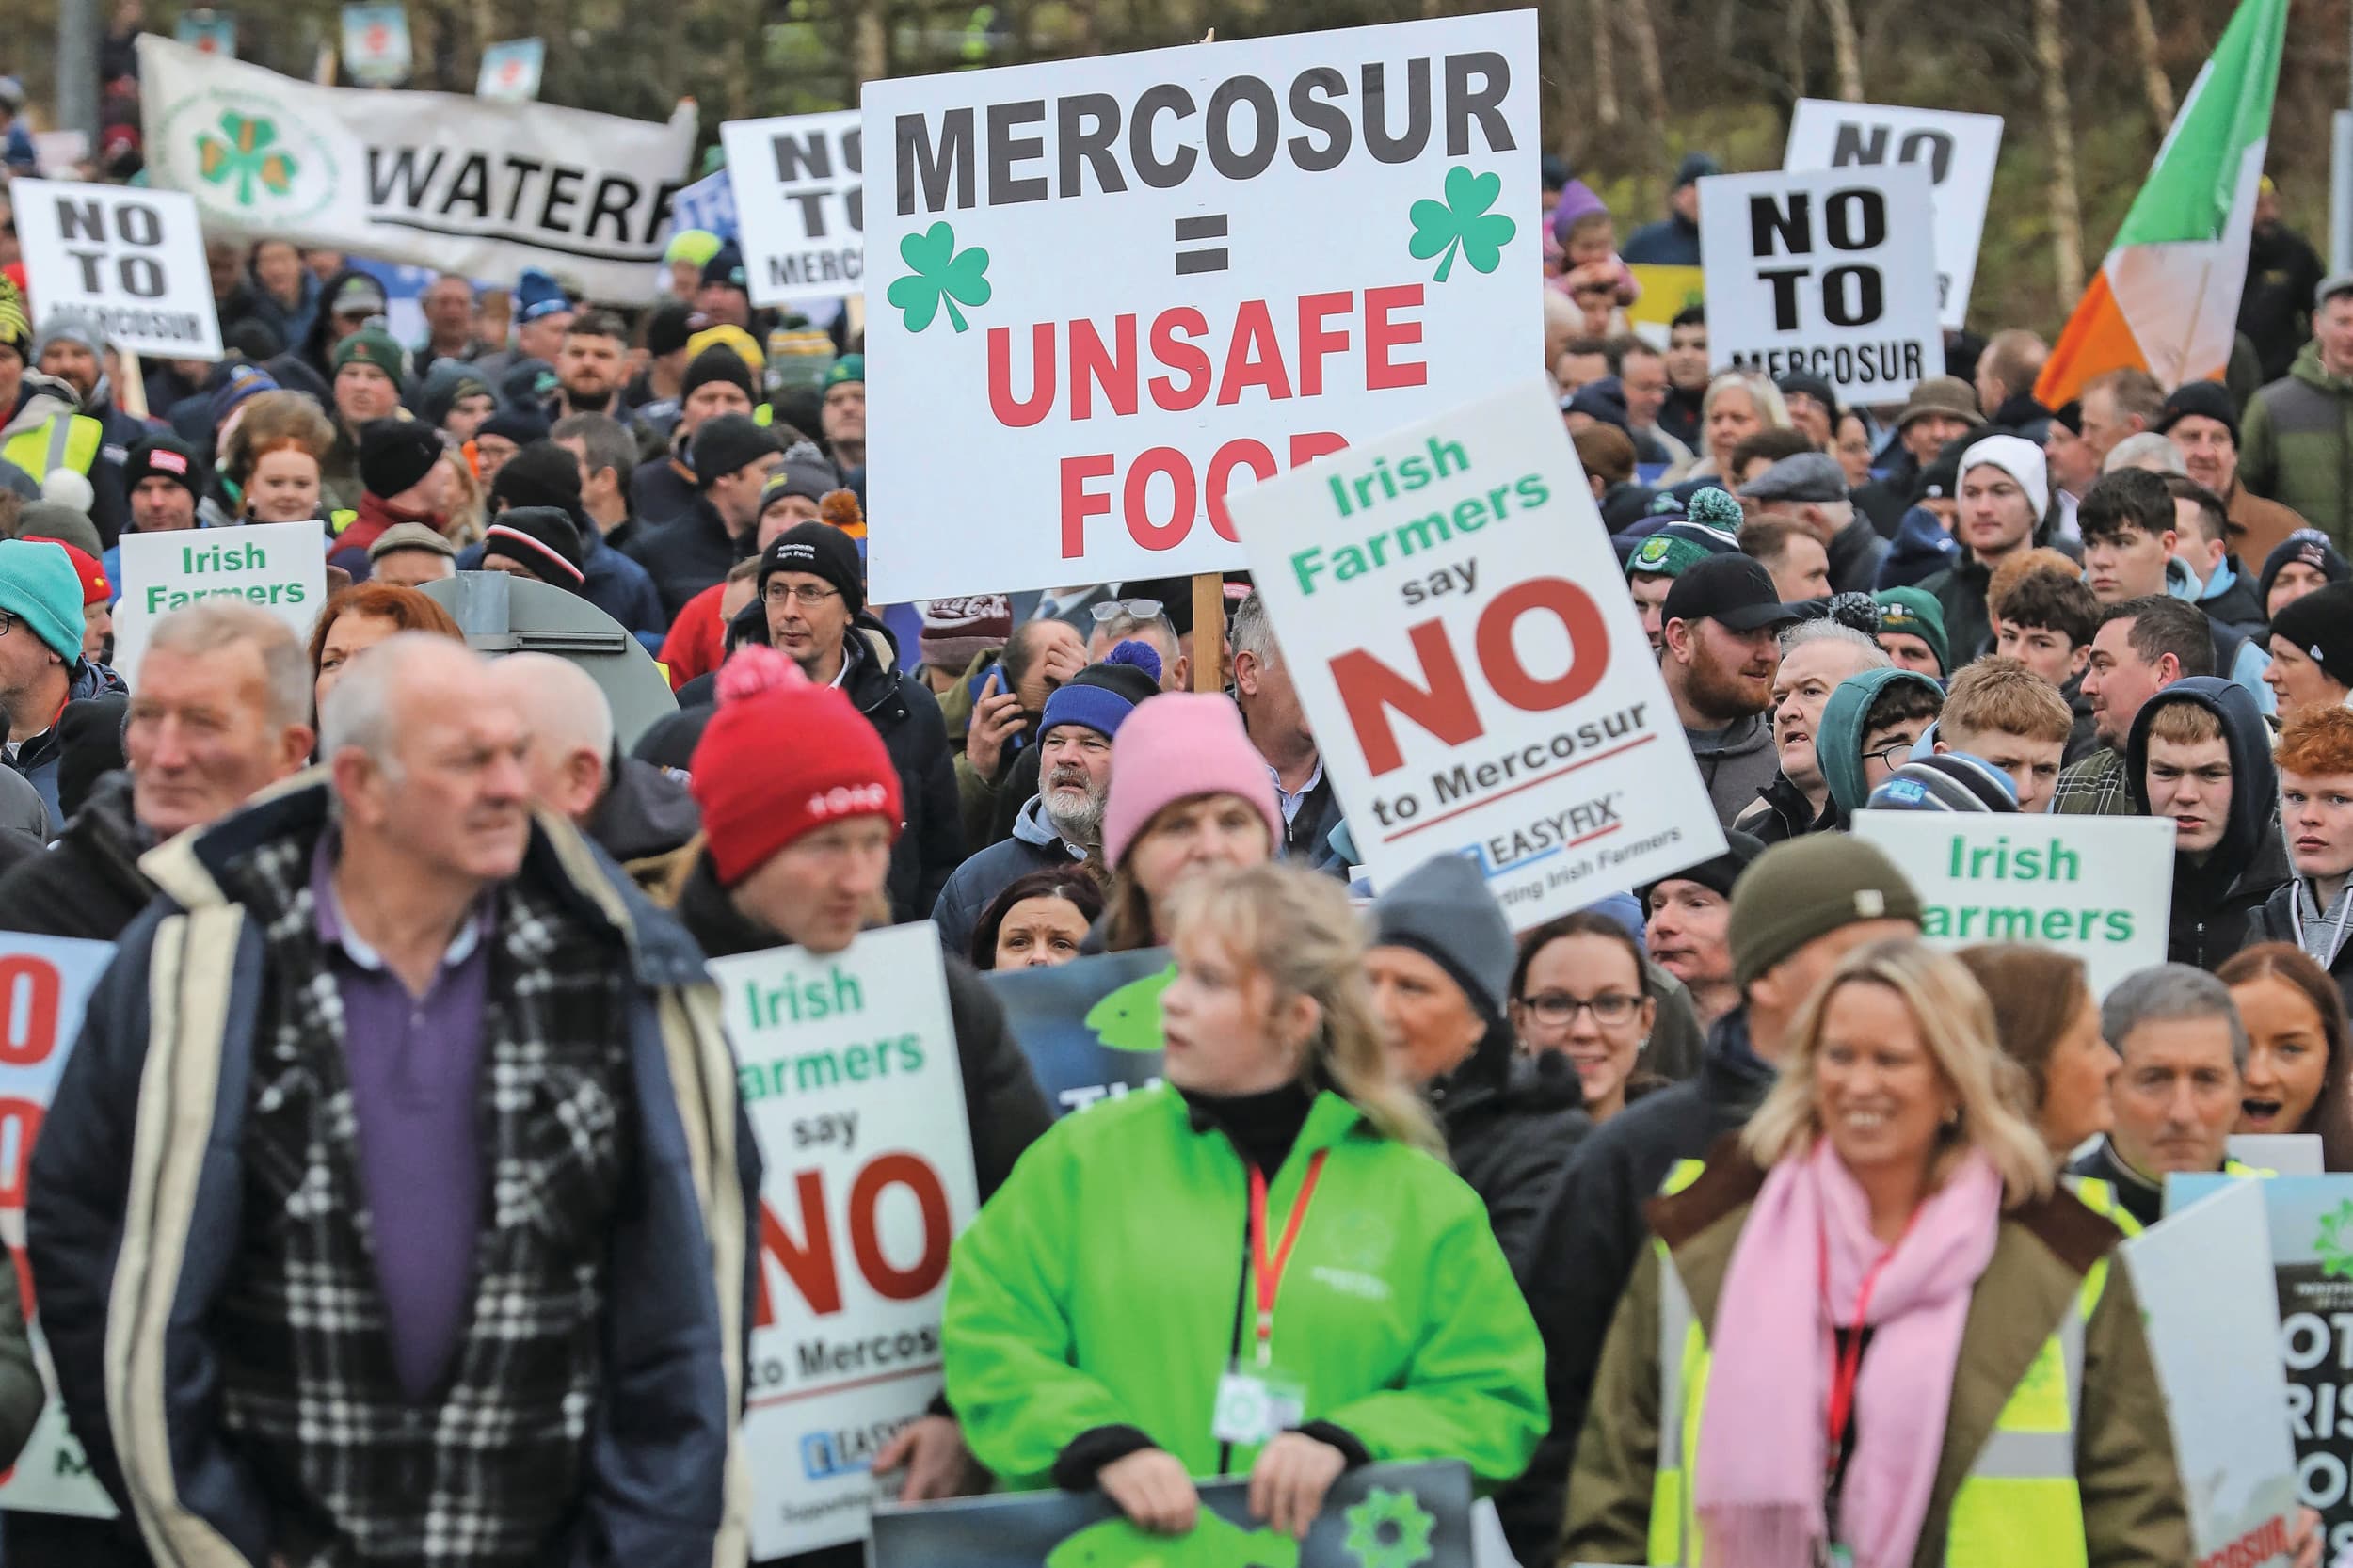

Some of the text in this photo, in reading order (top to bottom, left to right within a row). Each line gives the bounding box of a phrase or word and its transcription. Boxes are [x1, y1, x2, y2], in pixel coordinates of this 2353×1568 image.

[895, 51, 1518, 216] MERCOSUR
[55, 196, 164, 247] NO
[1749, 188, 1886, 257] NO
[67, 248, 166, 298] TO
[1756, 265, 1883, 331] TO
[987, 283, 1428, 427] UNSAFE
[1327, 436, 1471, 519] Irish
[181, 541, 266, 574] Irish
[1289, 472, 1552, 598] Farmers
[1401, 558, 1479, 606] say
[1327, 575, 1611, 778] NO
[1371, 702, 1649, 828] to Mercosur
[1546, 859, 1595, 889] Irish
[1596, 826, 1683, 871] Farmers
[1947, 834, 2080, 882] Irish
[1922, 904, 2135, 943] armers
[744, 964, 864, 1032] Irish
[738, 1032, 926, 1105] armers
[792, 1111, 858, 1152] say
[754, 1152, 951, 1329] NO
